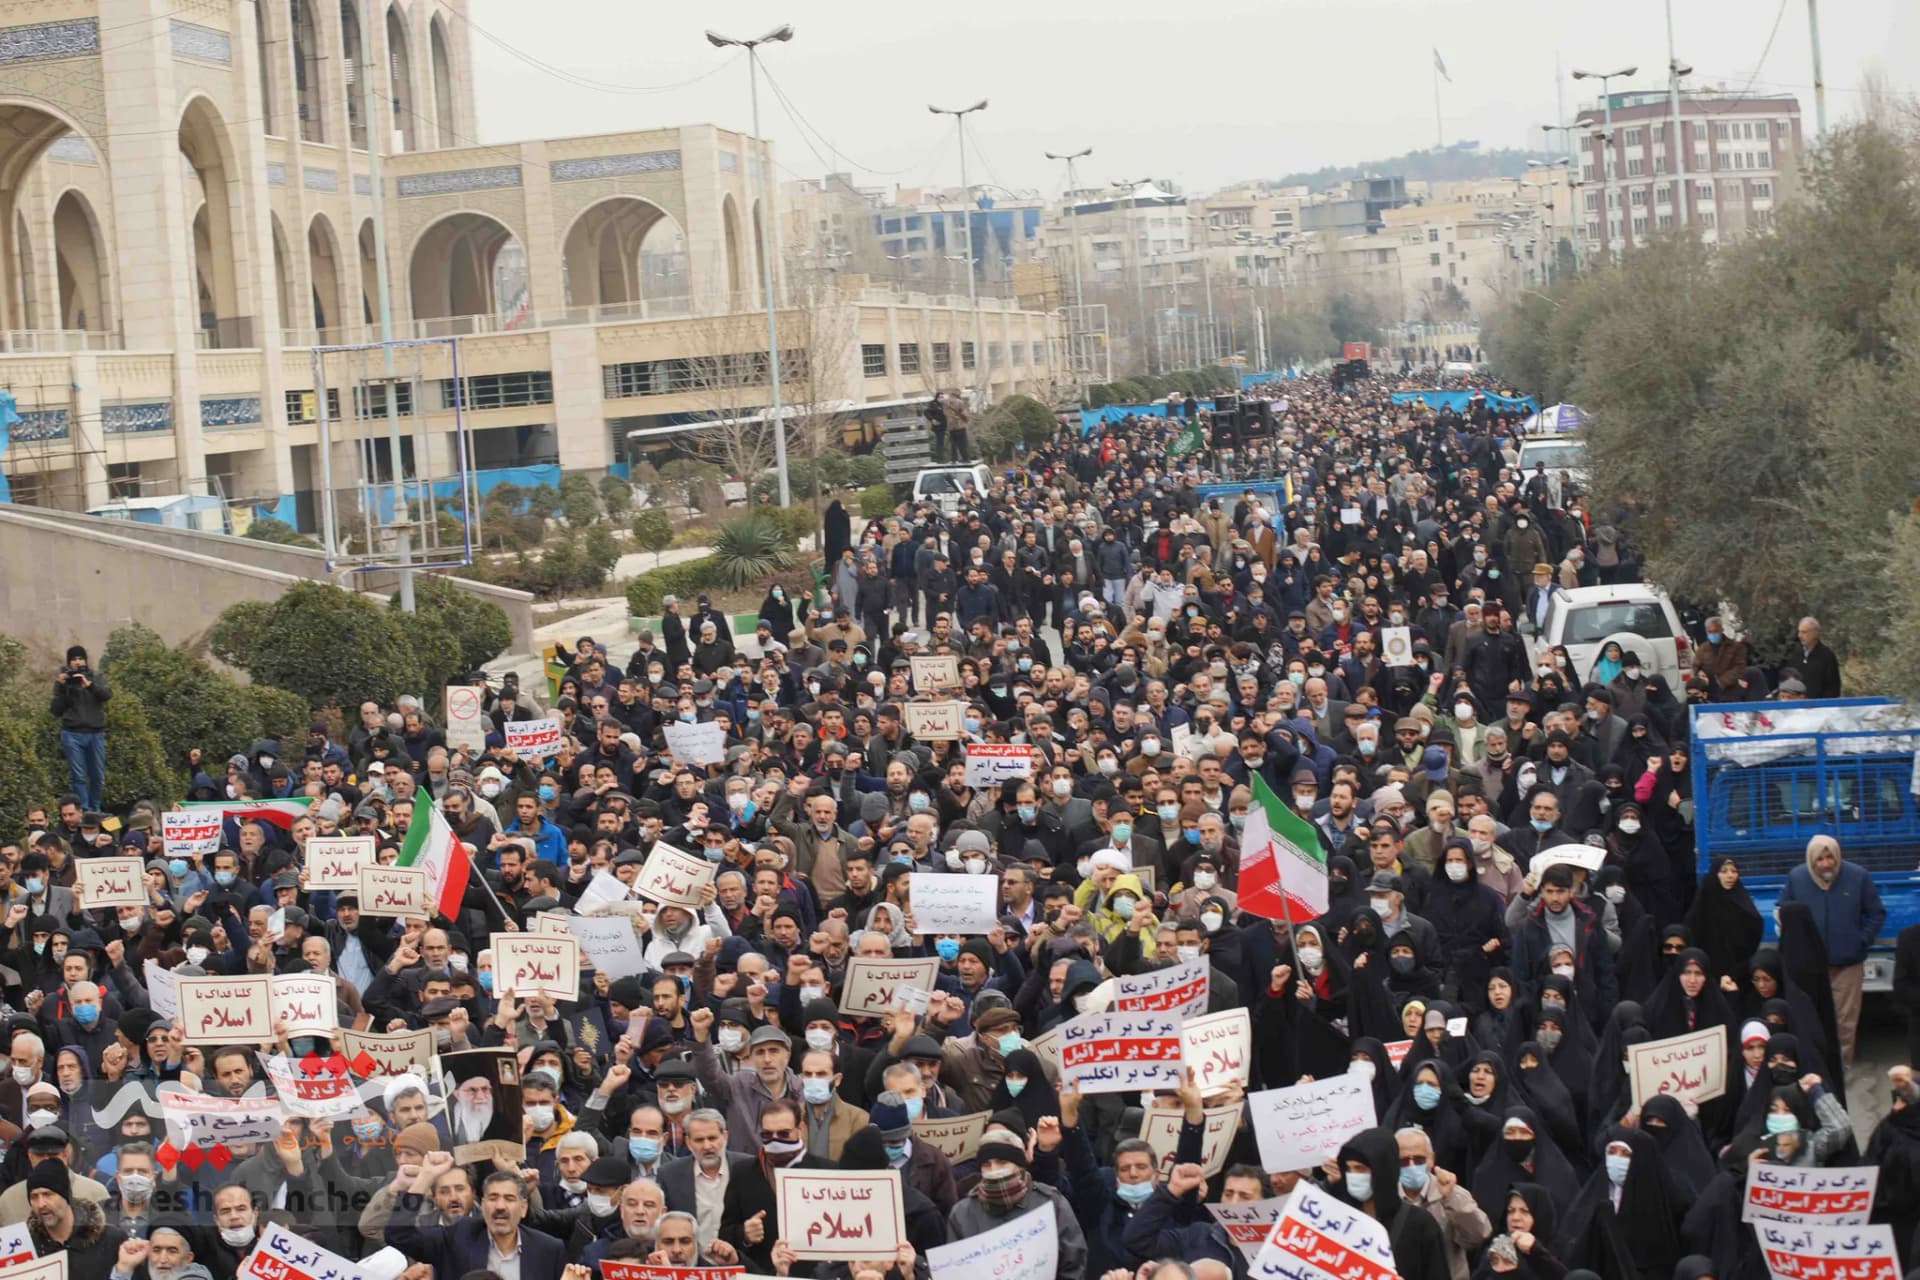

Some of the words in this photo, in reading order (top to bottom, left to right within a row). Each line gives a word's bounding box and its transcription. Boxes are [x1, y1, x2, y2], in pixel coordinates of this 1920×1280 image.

[919, 719, 950, 734] اسلام
[321, 862, 359, 882] اسلام
[97, 880, 132, 899] اسلام
[650, 873, 693, 896] اسلام
[374, 890, 412, 908] اسلام
[511, 944, 519, 954] یا
[521, 944, 546, 954] فداک
[547, 946, 563, 954] کلنا
[515, 961, 561, 987] اسلام
[866, 971, 875, 981] یا
[875, 971, 901, 980] فداک
[903, 971, 920, 980] کلنا
[1166, 975, 1176, 987] بر
[1178, 966, 1203, 983] مرگ
[195, 989, 205, 999] یا
[205, 988, 232, 998] فداک
[235, 988, 252, 998] کلنا
[1120, 978, 1159, 996] آمریکا
[1179, 980, 1207, 999] مرگ
[201, 1007, 252, 1034] اسلام
[1137, 1019, 1174, 1036] مرگ
[1065, 1019, 1112, 1041] آمریکا
[1120, 1022, 1133, 1037] بر
[358, 1042, 368, 1051] یا
[367, 1043, 396, 1052] فداک
[398, 1042, 416, 1051] کلنا
[1064, 1041, 1120, 1067] اسرائیل
[1125, 1045, 1139, 1061] بر
[1142, 1042, 1179, 1060] مرگ
[1692, 1044, 1707, 1057] کلنا
[1652, 1055, 1661, 1065] یا
[1661, 1049, 1690, 1063] فداک
[1142, 1066, 1180, 1081] مرگ
[1202, 1048, 1245, 1085] اسلام
[1125, 1069, 1138, 1084] بر
[1757, 1170, 1809, 1189] آمریکا
[1811, 1177, 1826, 1190] بر
[1831, 1174, 1867, 1189] مرگ
[801, 1187, 811, 1204] یا
[812, 1187, 847, 1201] فداک
[850, 1188, 873, 1201] کلنا
[1751, 1188, 1810, 1212] اسرائیل
[1832, 1193, 1868, 1212] مرگ
[1814, 1195, 1829, 1213] بر
[1217, 1206, 1261, 1223] آمریکا
[1298, 1195, 1358, 1235] آمریکا
[806, 1212, 873, 1248] اسلام
[1275, 1224, 1347, 1270] اسرائیل
[1764, 1228, 1813, 1252] آمریکا
[1823, 1238, 1837, 1255] بر
[1841, 1236, 1883, 1255] مرگ
[269, 1233, 323, 1268] آمریکا
[1771, 1254, 1832, 1280] اسرائیل
